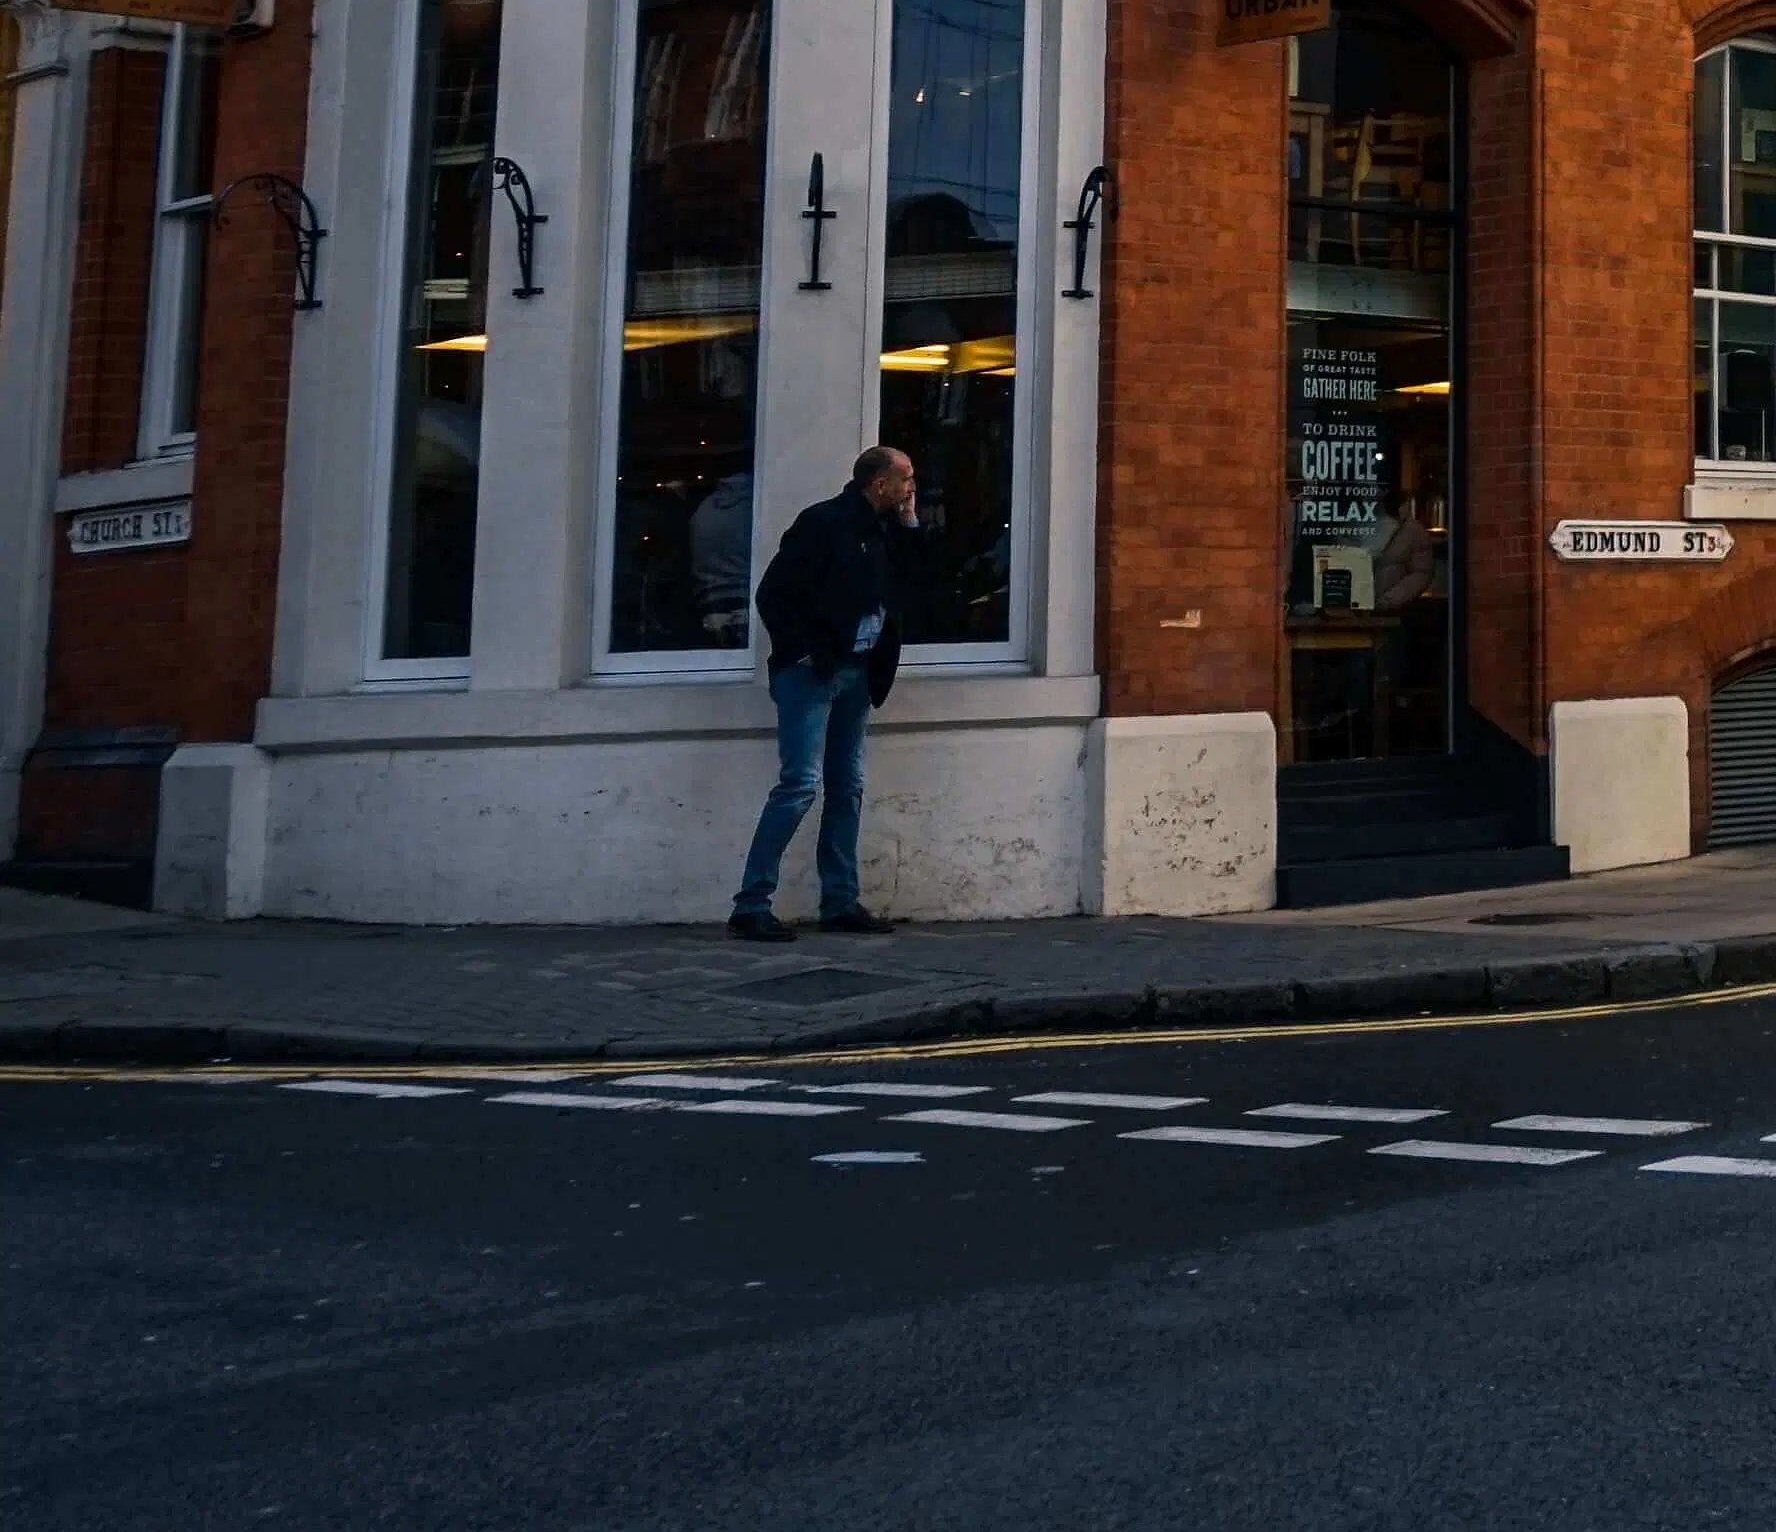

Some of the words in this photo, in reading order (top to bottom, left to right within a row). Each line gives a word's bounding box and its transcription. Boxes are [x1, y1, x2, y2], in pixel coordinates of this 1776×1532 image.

[1303, 348, 1337, 361] FINE
[1340, 349, 1377, 363] FOLK
[1303, 364, 1315, 373] OF
[1318, 365, 1347, 373] GREAT
[1350, 366, 1377, 376] TASTE
[1303, 376, 1346, 400] GATHER
[1349, 379, 1377, 401] HERE
[1303, 422, 1323, 436] TO
[1328, 423, 1377, 437] DRINK
[1302, 440, 1378, 481] COFFEE
[1303, 486, 1341, 497] ENJOY
[1345, 486, 1377, 497] FOOD
[1302, 500, 1378, 522] RELAX
[80, 515, 143, 544] CHURCH
[1302, 527, 1322, 536] AND
[1326, 527, 1377, 536] CONVERSE
[1571, 531, 1661, 553] EDMUND
